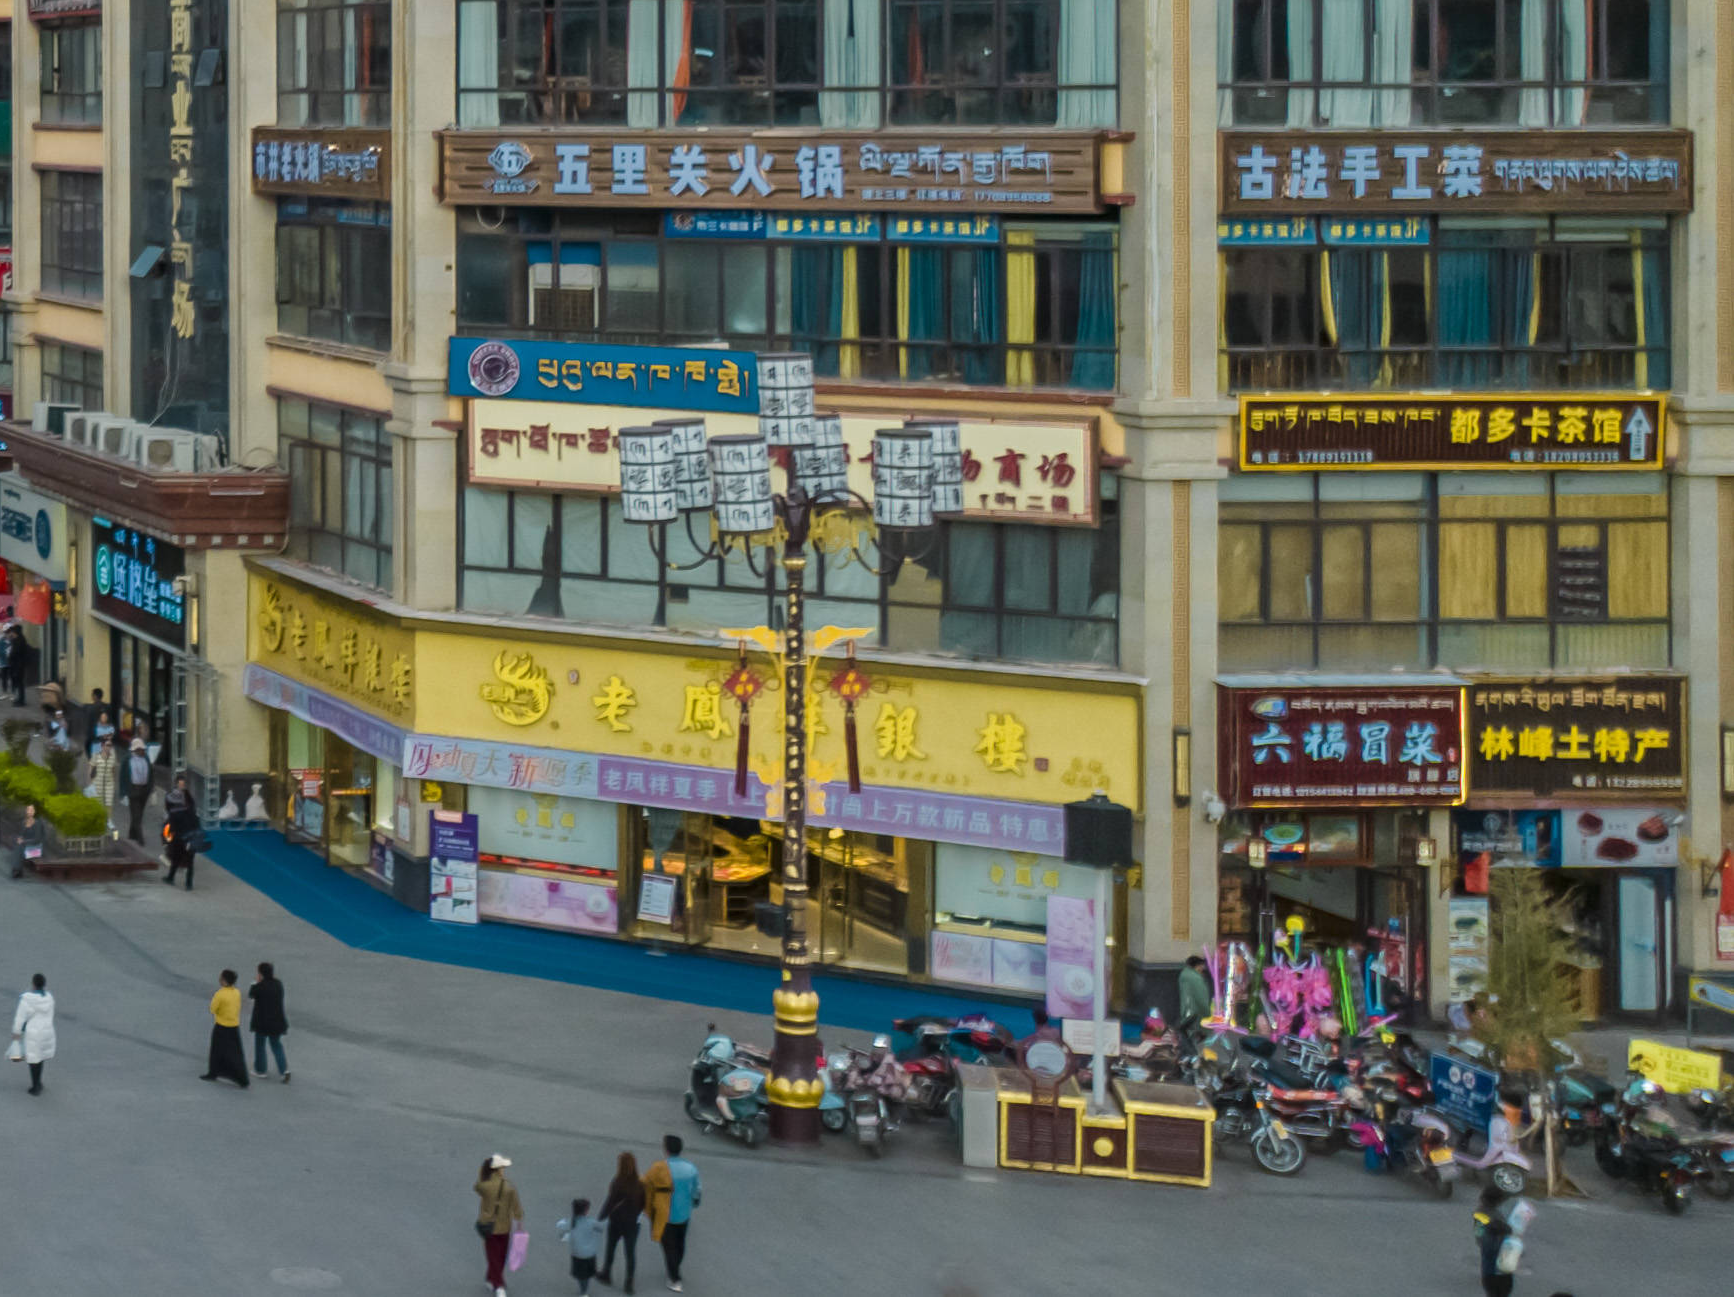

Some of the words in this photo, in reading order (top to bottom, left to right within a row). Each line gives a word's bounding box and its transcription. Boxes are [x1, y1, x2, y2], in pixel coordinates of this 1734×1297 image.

[553, 144, 844, 199] 五里关火锅
[1236, 146, 1484, 200] 古法手工菜
[1449, 406, 1623, 445] 都多卡茶馆
[1251, 721, 1443, 765] 六福冒菜
[1480, 724, 1670, 763] 林峰土特产
[603, 768, 716, 801] 老凤祥夏季
